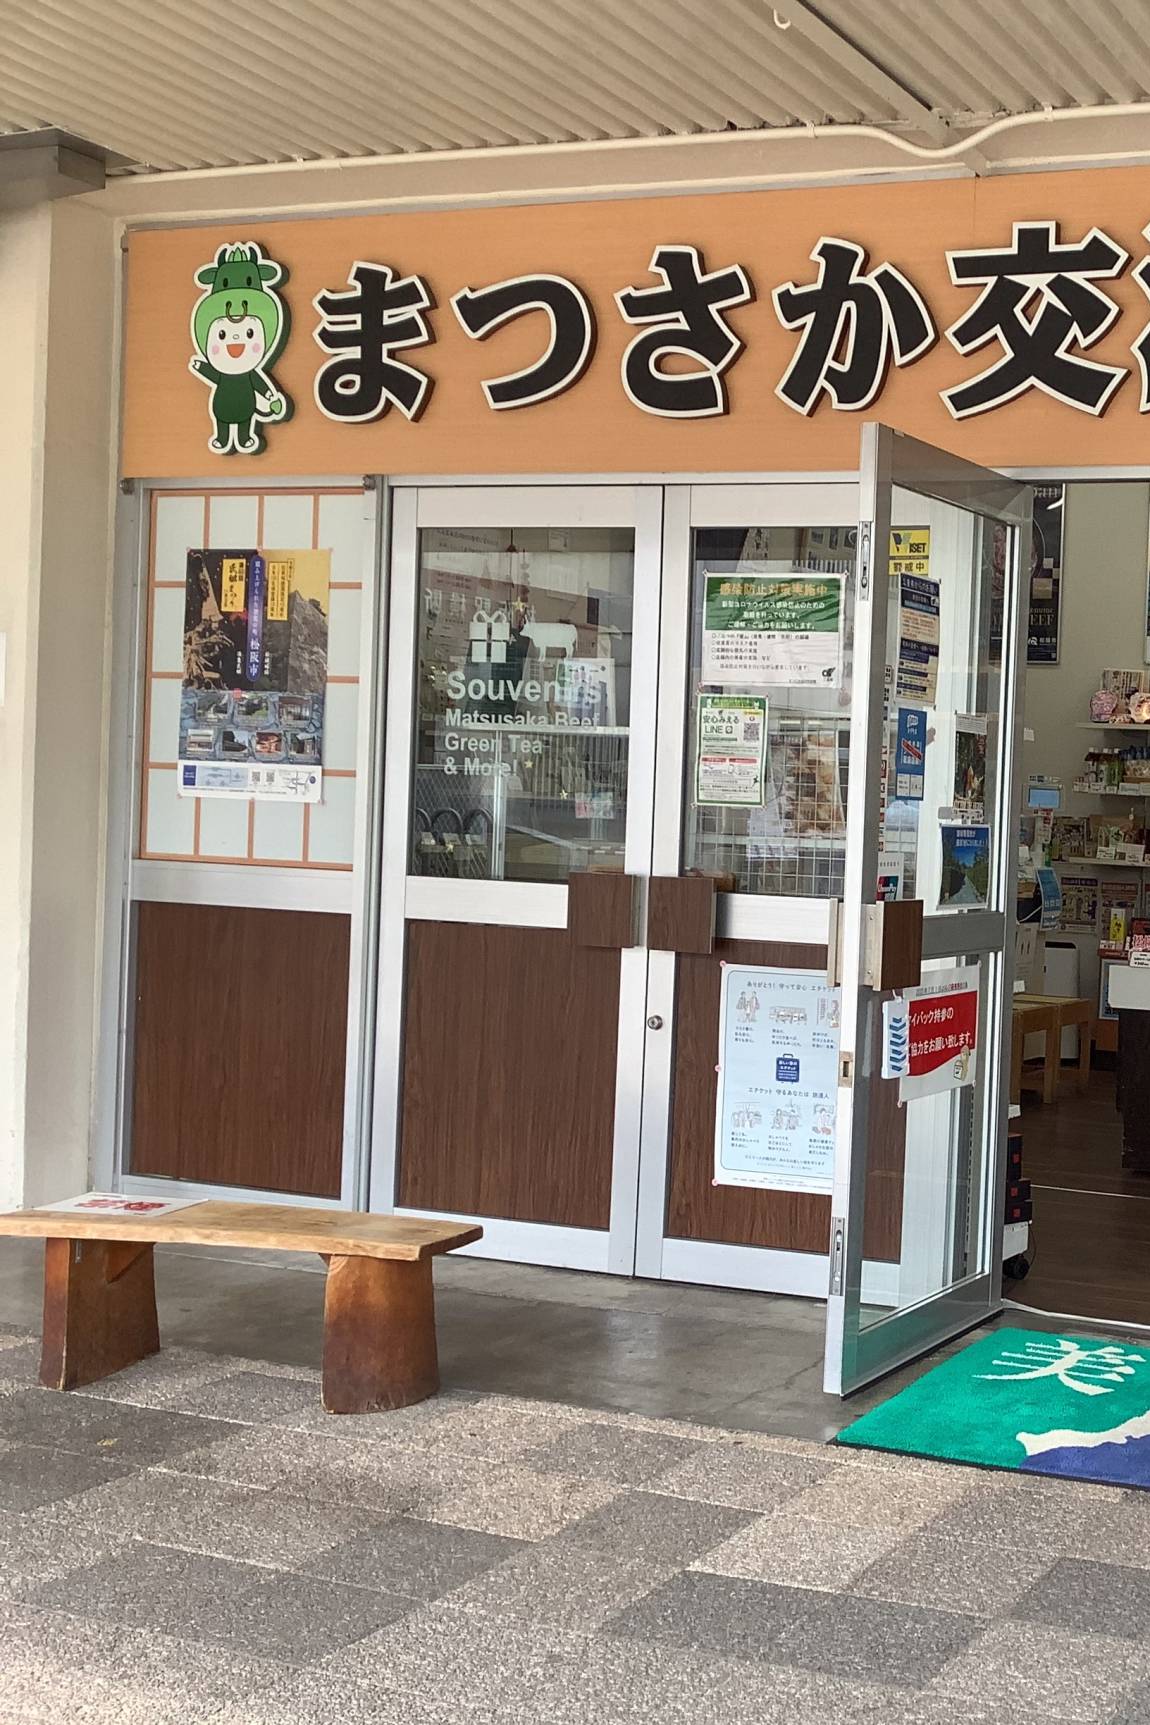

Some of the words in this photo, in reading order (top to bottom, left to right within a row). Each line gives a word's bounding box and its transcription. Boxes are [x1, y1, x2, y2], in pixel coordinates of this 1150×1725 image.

[249, 639, 260, 677] 松阪市
[446, 671, 600, 704] Souvens
[445, 708, 548, 728] Matsusaka
[555, 711, 600, 731] Beef
[704, 725, 723, 734] LINE
[444, 732, 502, 752] Green
[508, 735, 543, 754] Tea
[443, 757, 458, 775] &
[464, 757, 517, 777] More!
